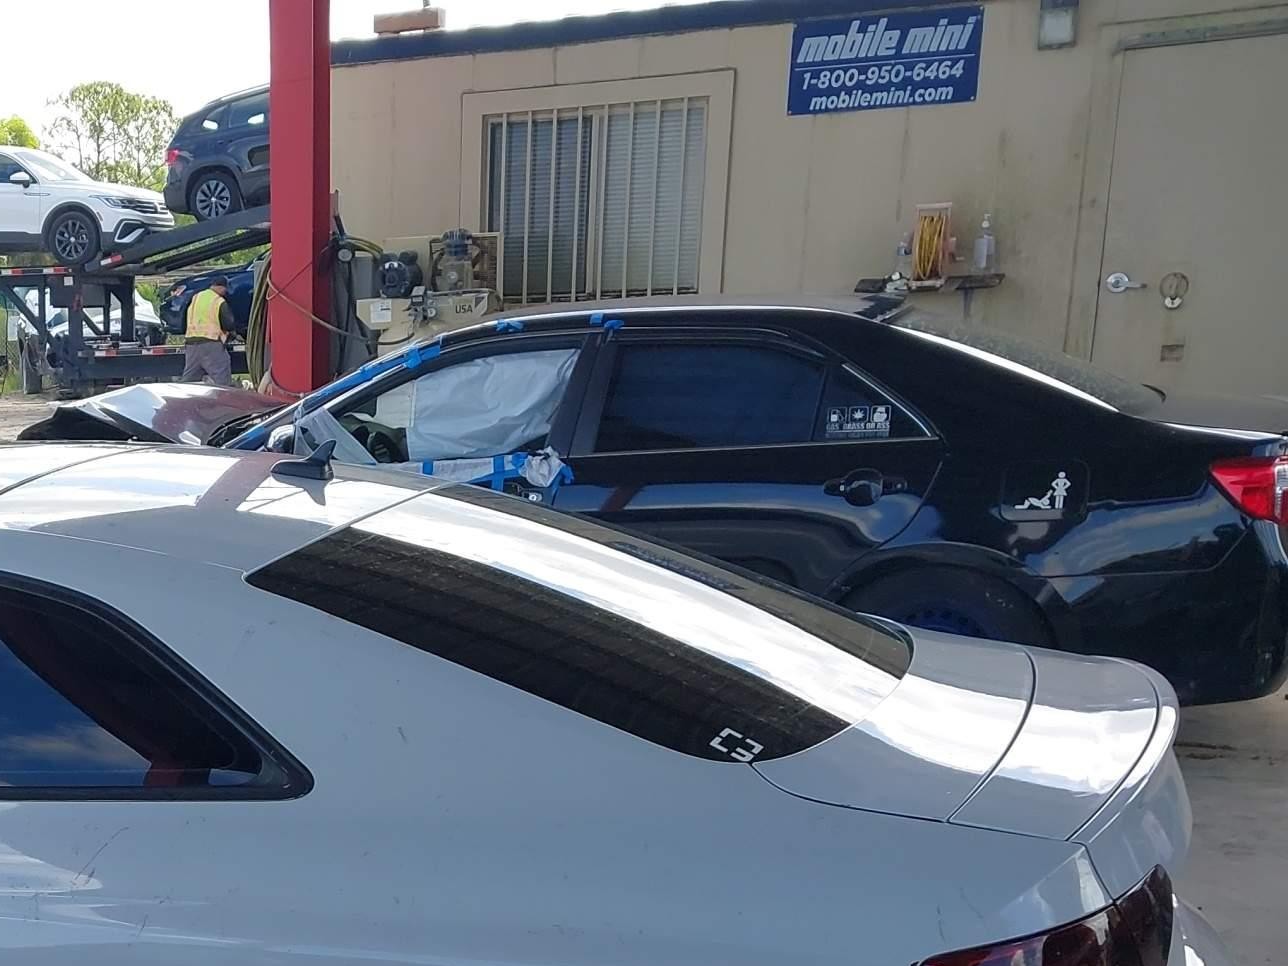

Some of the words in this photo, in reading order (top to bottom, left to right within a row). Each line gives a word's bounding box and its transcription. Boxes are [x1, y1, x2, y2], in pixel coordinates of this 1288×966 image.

[796, 17, 901, 64] mobile
[901, 15, 978, 55] mini
[802, 59, 965, 90] 1-800-950-6464
[809, 85, 954, 111] mobilemini.com
[455, 305, 473, 314] USA
